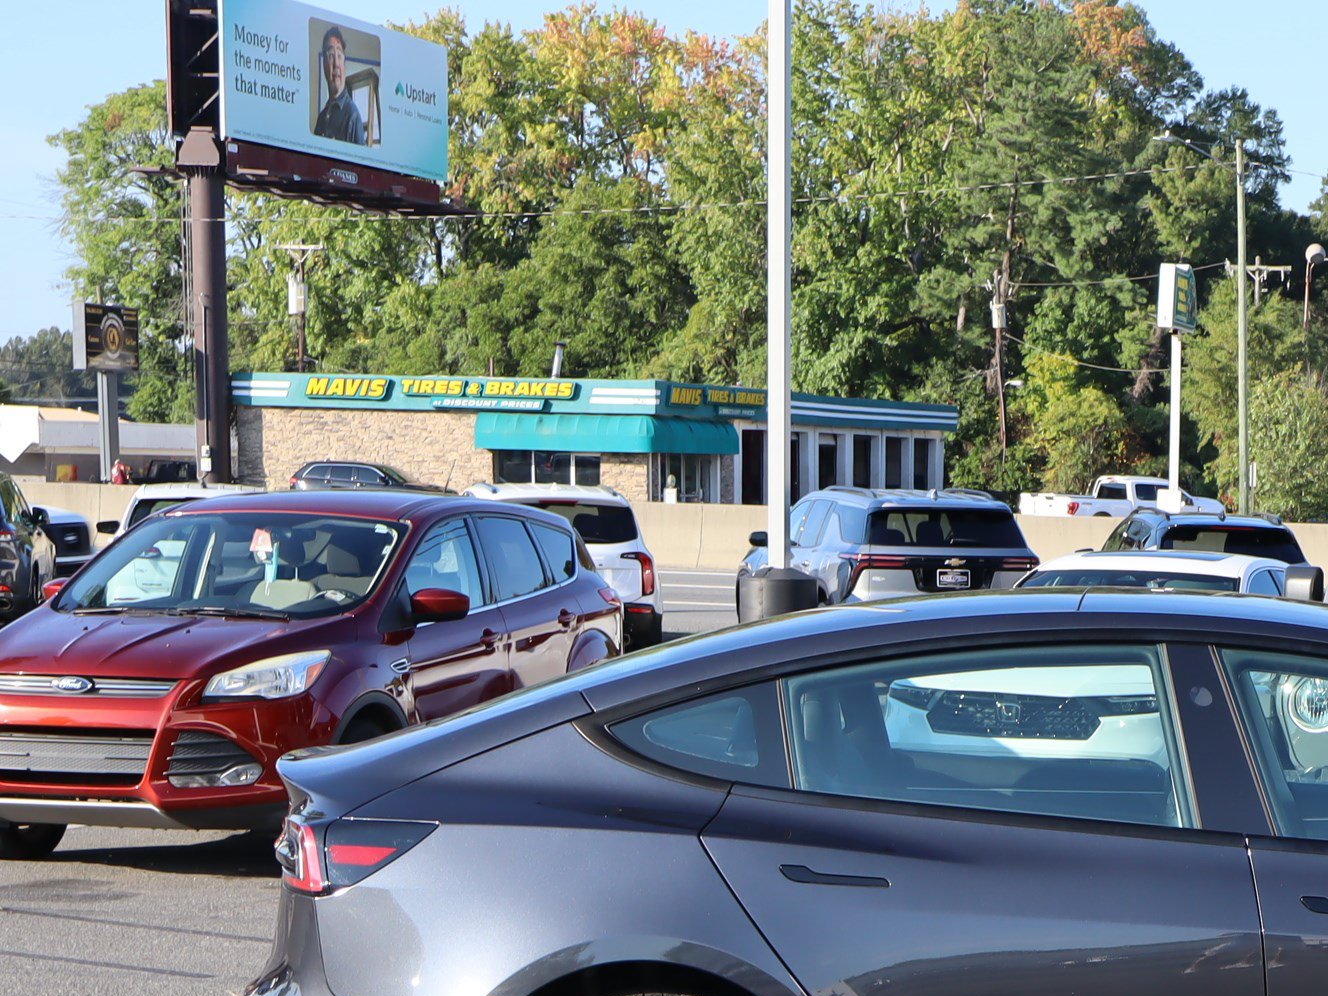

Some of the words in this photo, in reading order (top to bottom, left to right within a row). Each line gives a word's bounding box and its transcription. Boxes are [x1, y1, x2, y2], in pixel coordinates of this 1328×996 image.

[234, 23, 272, 54] Money
[274, 34, 289, 54] for
[234, 49, 252, 69] the
[254, 58, 302, 82] moments
[235, 73, 258, 96] that
[260, 84, 297, 105] matter
[405, 83, 437, 107] Upstart
[305, 377, 388, 398] MAVIS
[401, 379, 463, 395] TIRES
[467, 383, 482, 395] &
[485, 381, 574, 397] BRAKES
[671, 387, 703, 405] MAVIS
[708, 389, 730, 403] TIRES
[443, 398, 498, 408] DISCOUNT
[500, 400, 542, 409] PRICES
